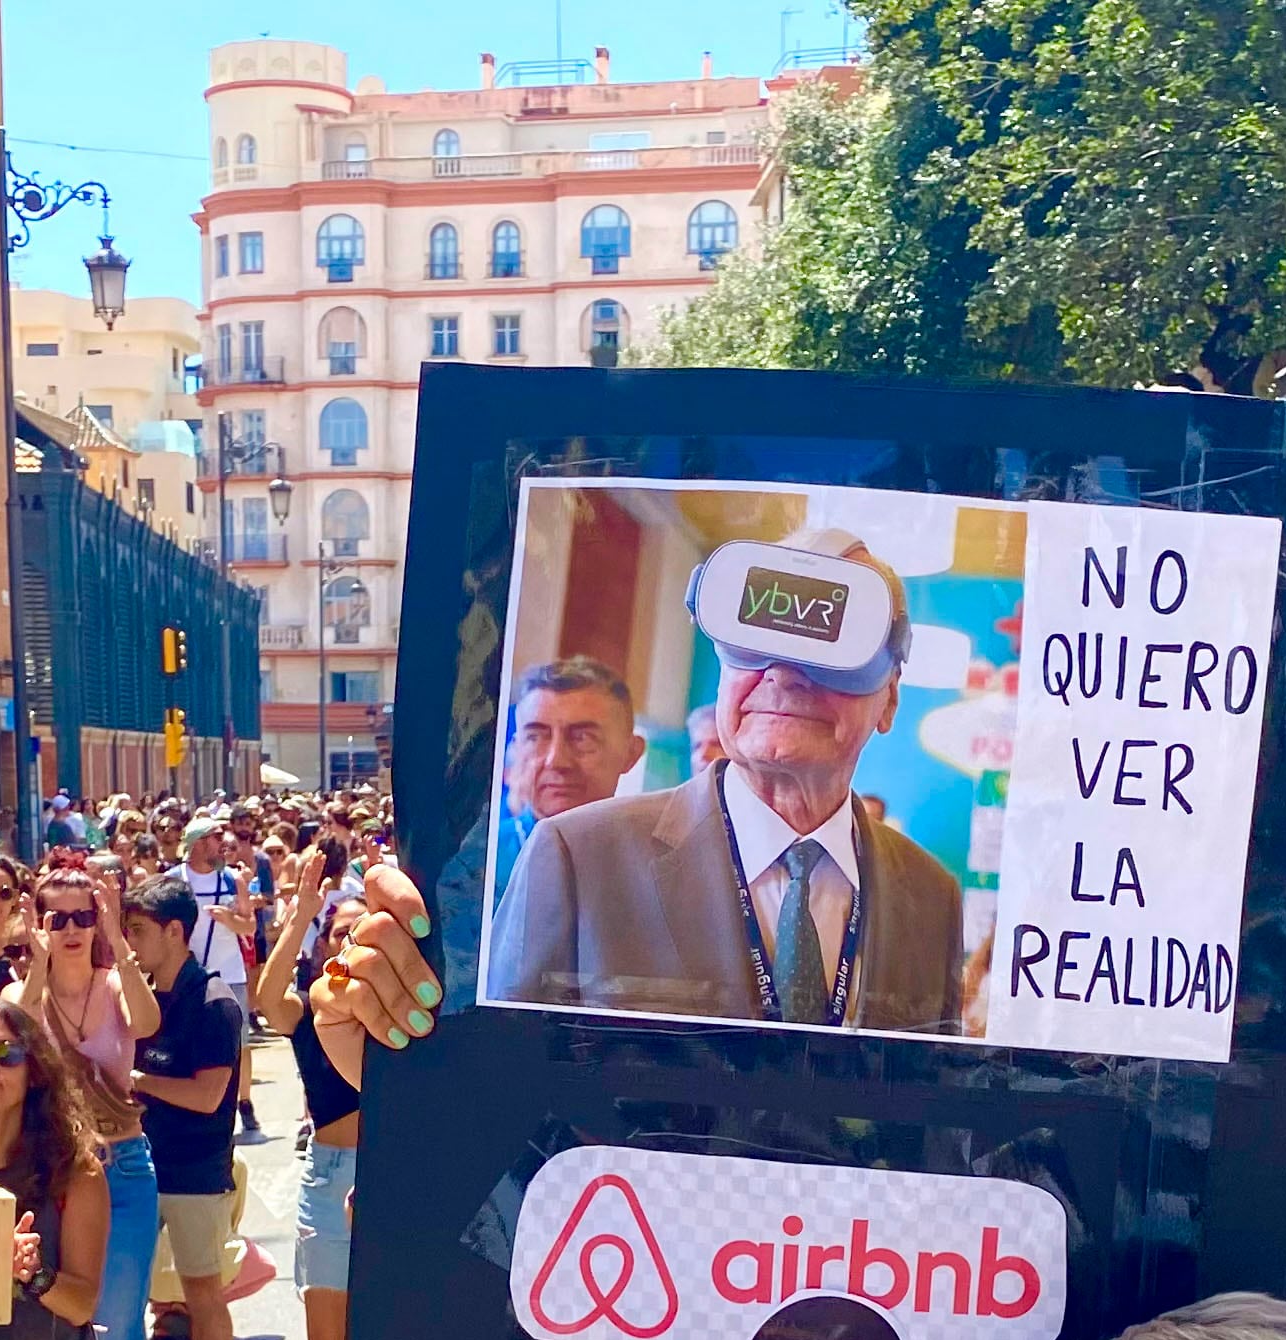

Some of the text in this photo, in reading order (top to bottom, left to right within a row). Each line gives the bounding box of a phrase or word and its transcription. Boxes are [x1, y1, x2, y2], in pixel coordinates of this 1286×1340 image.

[1081, 545, 1189, 616] NO
[1043, 633, 1259, 716] QUIERO
[1072, 737, 1195, 815] VER
[1071, 841, 1146, 909] LA
[1009, 924, 1233, 1015] REALIDAD
[711, 1214, 1041, 1319] airbnb
